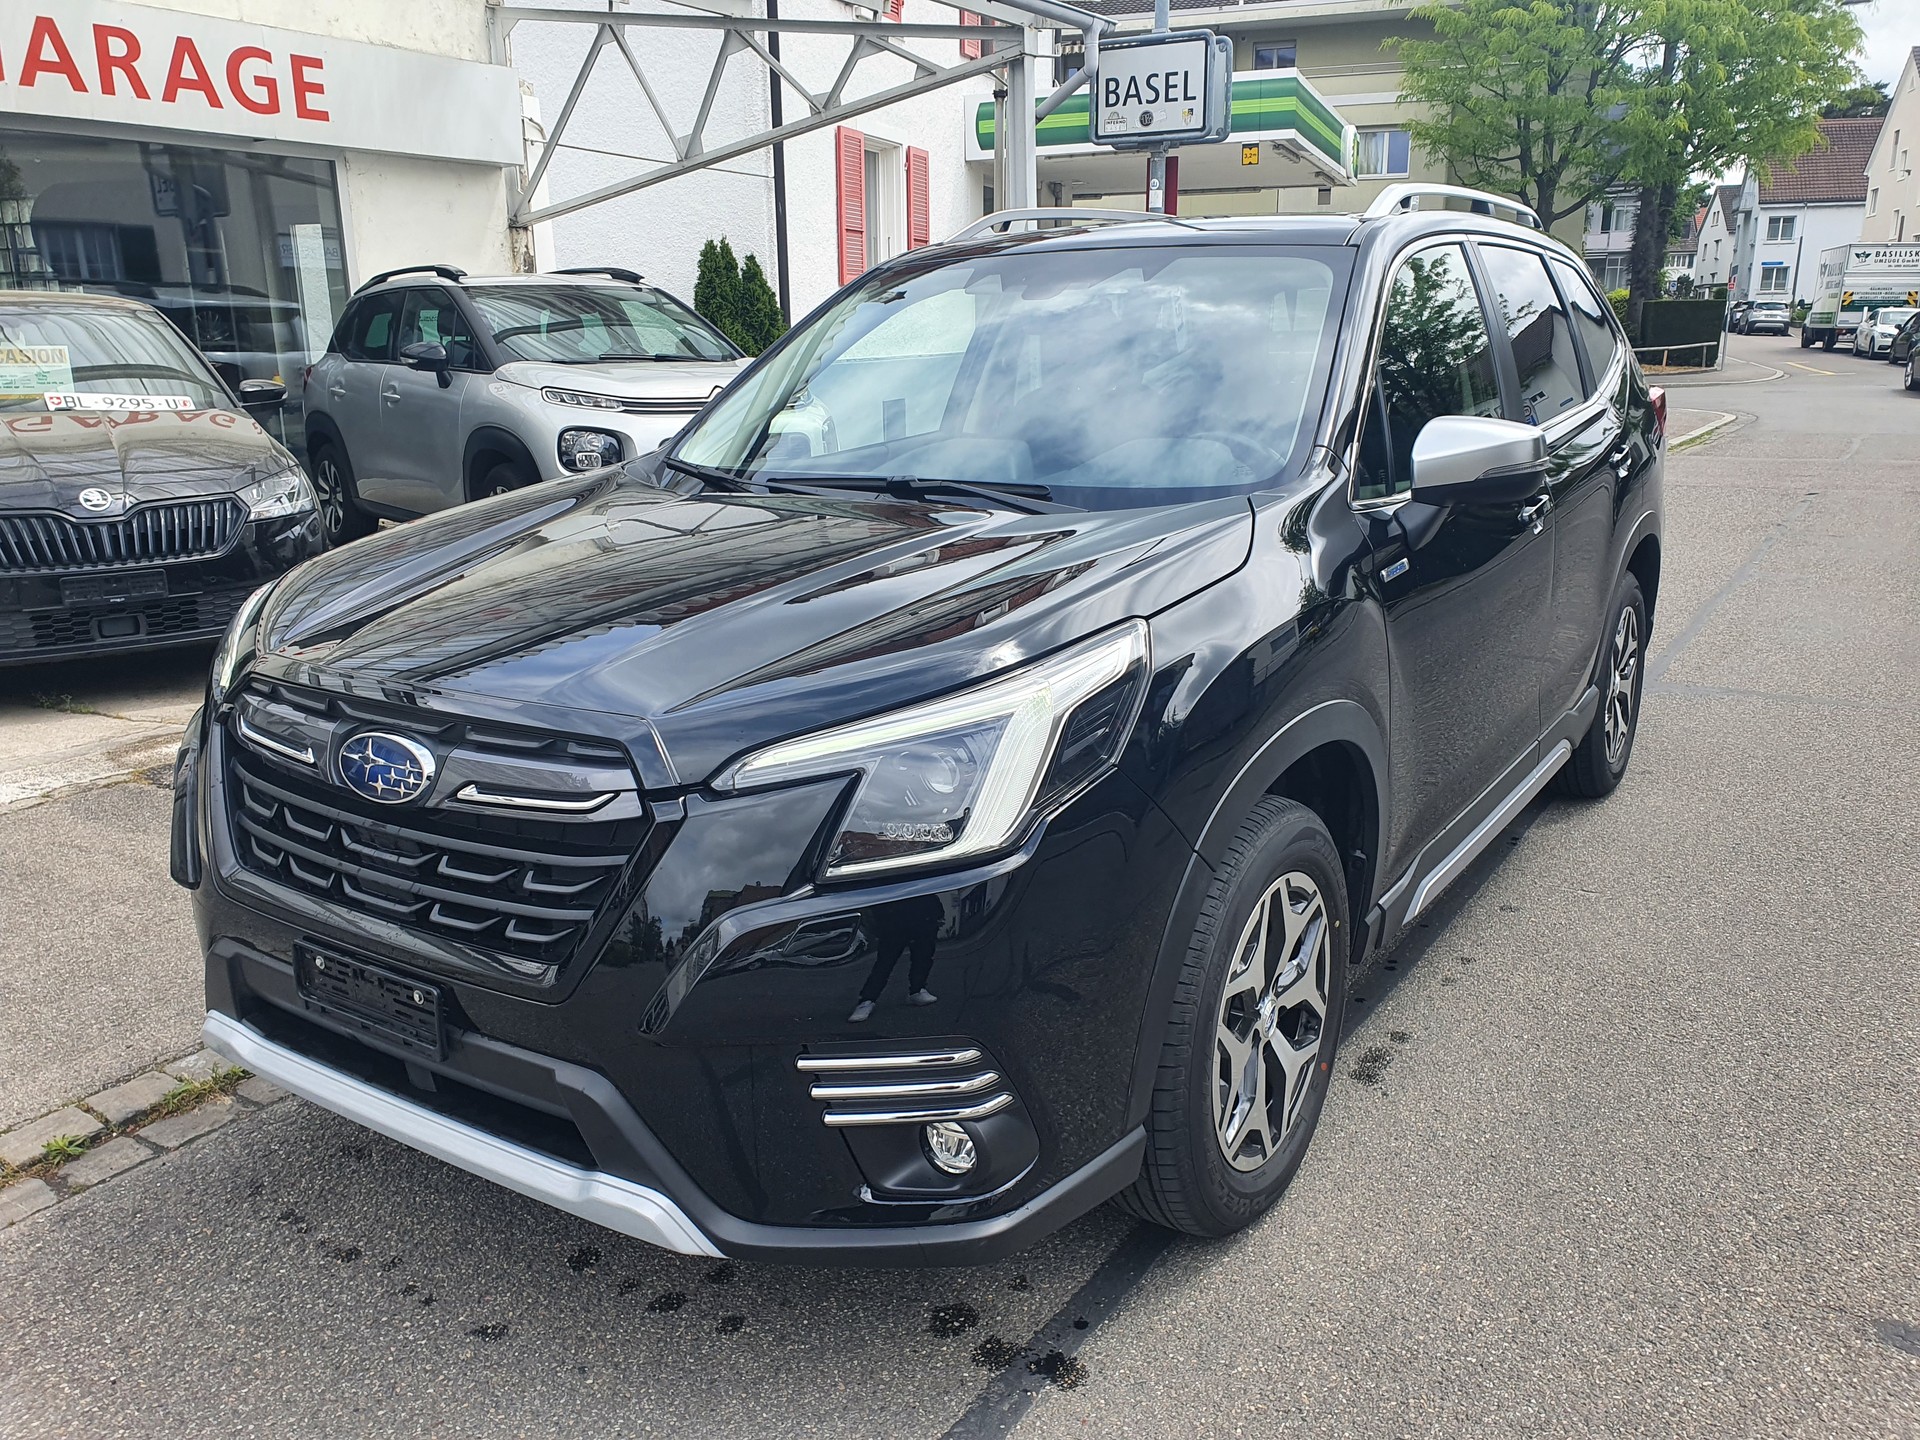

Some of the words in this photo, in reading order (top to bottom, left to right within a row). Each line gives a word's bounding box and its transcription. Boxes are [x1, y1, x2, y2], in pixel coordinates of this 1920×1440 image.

[0, 15, 331, 123] ARAGE
[1105, 71, 1197, 108] BASEL
[102, 397, 155, 410] 9295
